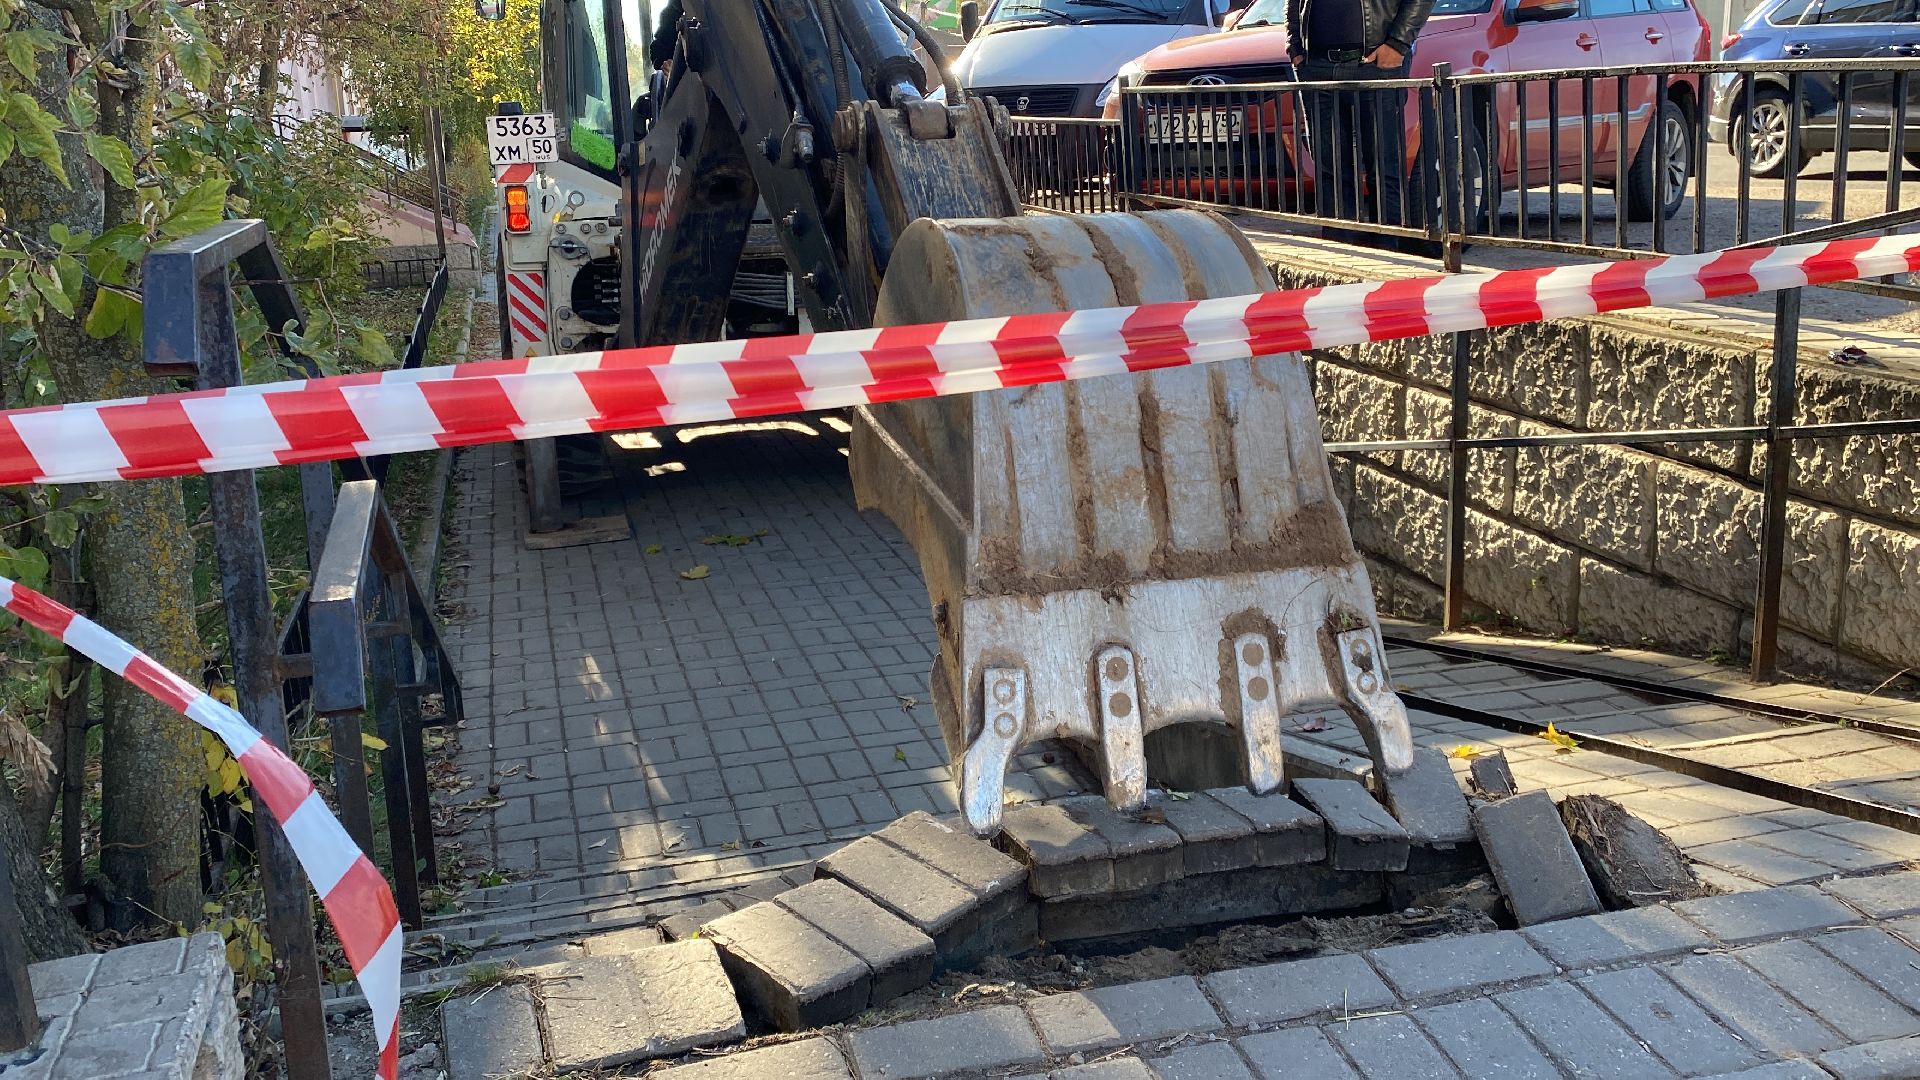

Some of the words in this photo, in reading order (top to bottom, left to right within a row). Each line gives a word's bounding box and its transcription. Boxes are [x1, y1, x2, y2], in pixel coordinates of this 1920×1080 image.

[495, 116, 547, 137] 5363
[494, 145, 521, 161] ХМ
[532, 139, 552, 154] 50
